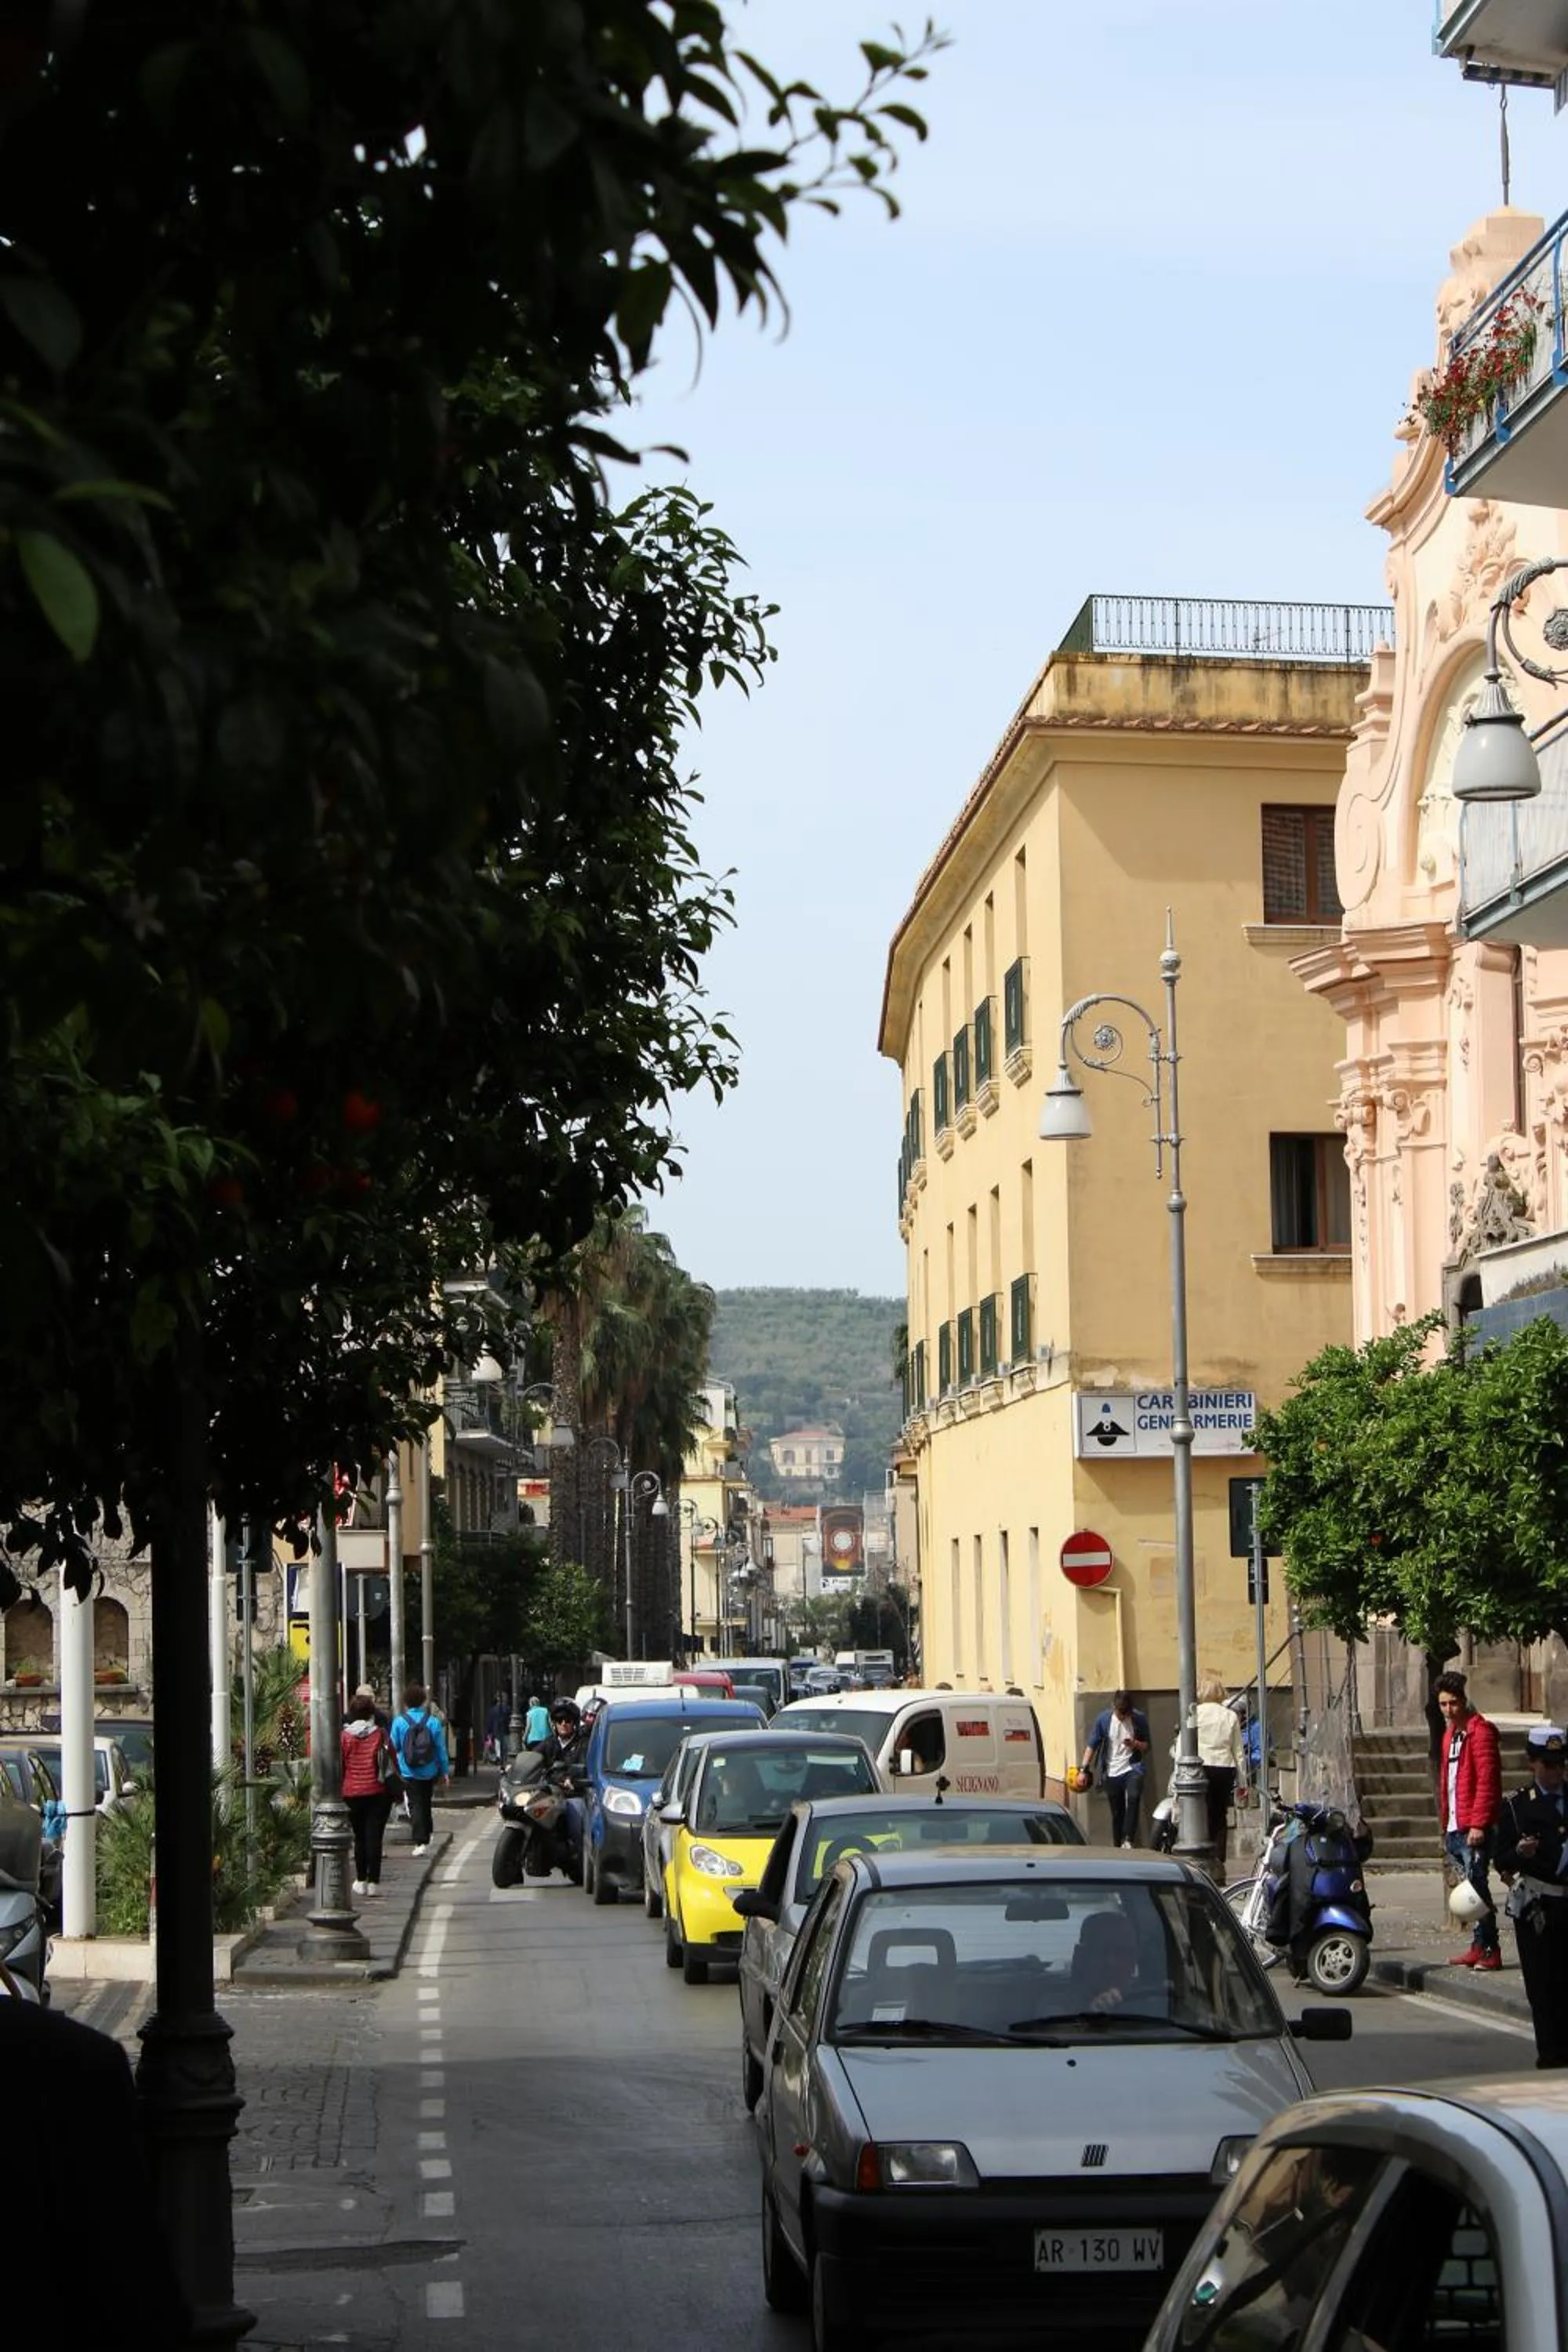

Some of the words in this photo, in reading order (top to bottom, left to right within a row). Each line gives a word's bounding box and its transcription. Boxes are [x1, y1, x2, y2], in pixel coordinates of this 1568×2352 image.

[1138, 1394, 1252, 1410] CARBINIERI
[1138, 1414, 1252, 1430] GENRMERIE
[1038, 2239, 1064, 2263] AR
[1080, 2238, 1120, 2262] 130
[1133, 2238, 1160, 2261] WV
